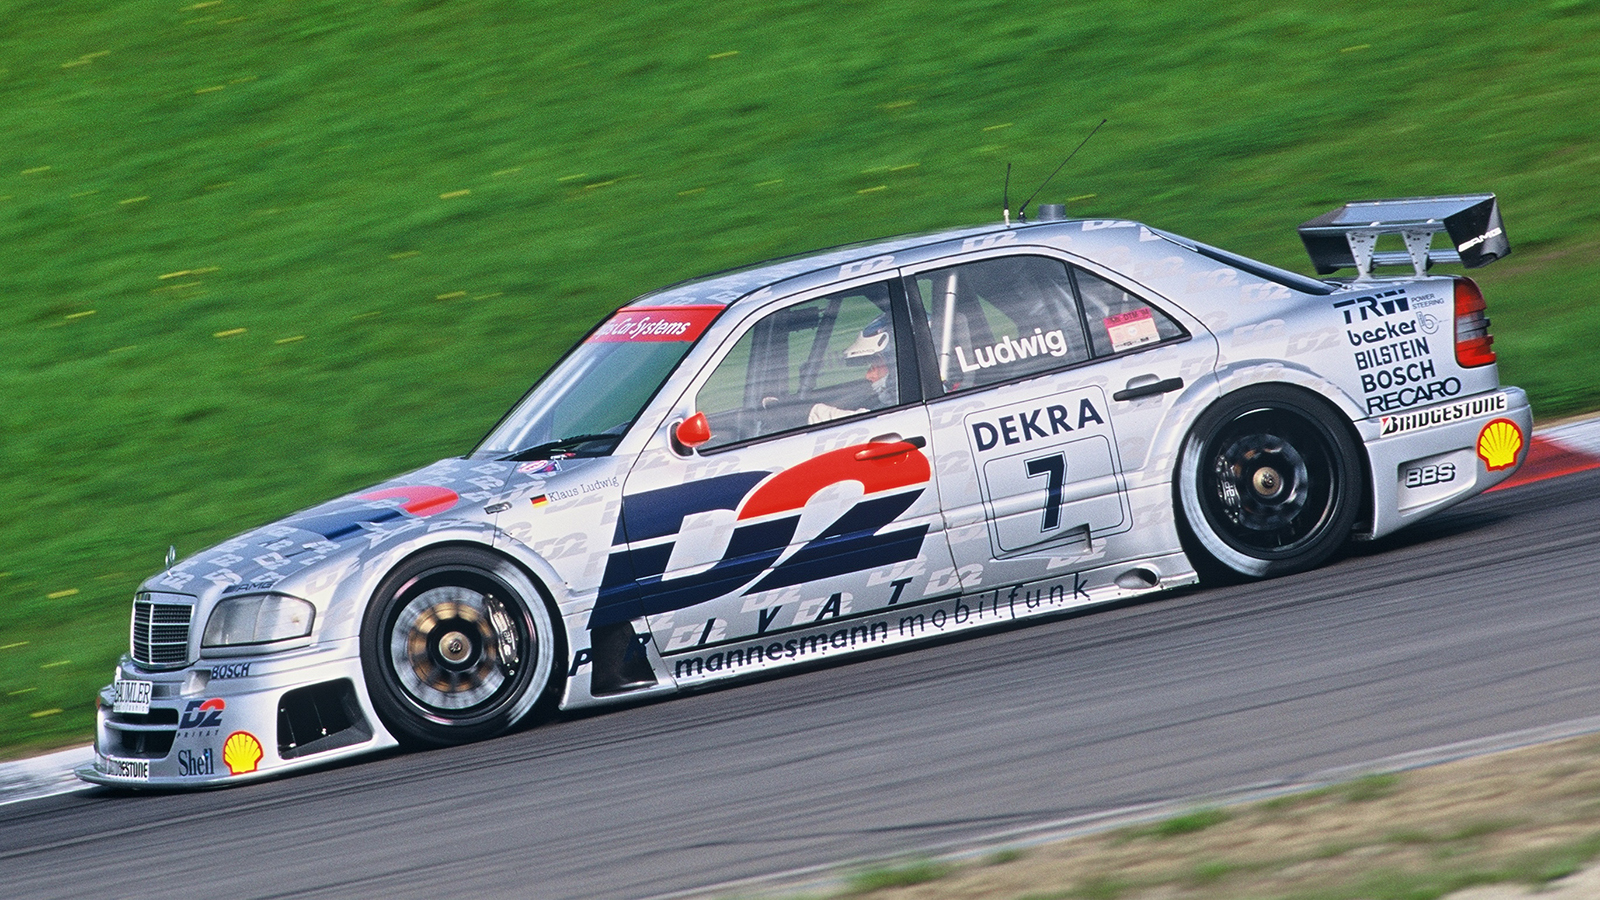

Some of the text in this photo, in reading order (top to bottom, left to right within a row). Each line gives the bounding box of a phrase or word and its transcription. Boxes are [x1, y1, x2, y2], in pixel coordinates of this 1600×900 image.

[1333, 288, 1410, 325] TRW
[1411, 293, 1435, 303] POWER
[1412, 297, 1445, 309] STEERING
[611, 318, 635, 336] Car
[628, 316, 691, 339] Systems
[1347, 319, 1417, 347] becker
[955, 327, 1068, 373] Ludwig
[1354, 336, 1430, 371] BILSTEIN
[1361, 359, 1436, 394] BOSCH
[1366, 377, 1462, 415] RECARO
[971, 398, 1105, 452] DEKRA
[1382, 393, 1507, 436] BRIDGESTONE
[547, 476, 620, 503] Klaus Ludwig
[1405, 462, 1456, 488] BBS
[1024, 451, 1068, 533] 7
[586, 442, 930, 630] D2
[674, 572, 1093, 679] mannesmann mobilfunk
[211, 663, 250, 680] BOSCH
[178, 697, 226, 730] D2
[177, 729, 219, 739] PRIVAT
[107, 759, 150, 779] ESTONE
[178, 748, 215, 777] Shell
